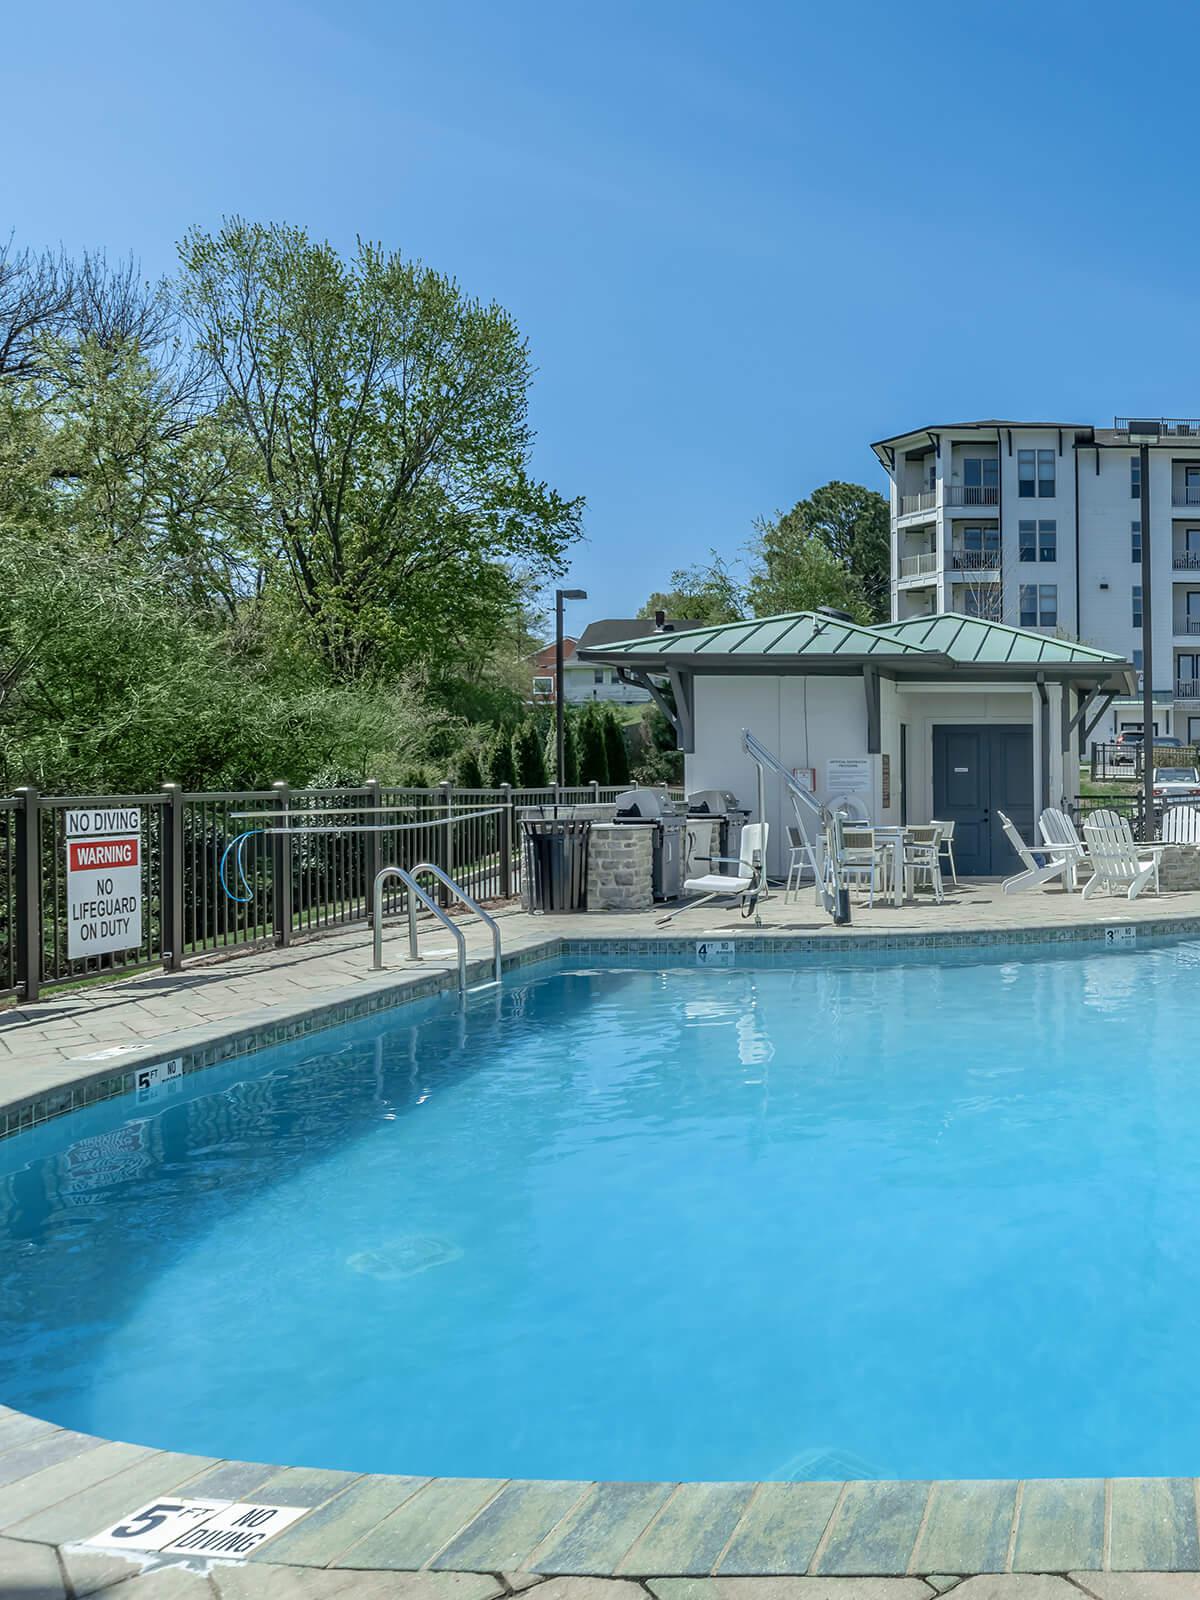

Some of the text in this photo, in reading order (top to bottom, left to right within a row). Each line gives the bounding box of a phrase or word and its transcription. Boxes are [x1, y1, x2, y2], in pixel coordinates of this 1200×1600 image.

[69, 811, 139, 833] NO DIVING
[76, 844, 132, 866] WARNING
[97, 878, 113, 897] NO
[72, 896, 137, 921] LIFEGUARD
[80, 917, 131, 941] ON DUTY
[698, 943, 708, 954] 4
[167, 1061, 177, 1075] NO
[138, 1072, 150, 1089] 5
[111, 1504, 216, 1538] 5 FT
[230, 1507, 279, 1528] NO
[174, 1528, 266, 1553] DIVING
